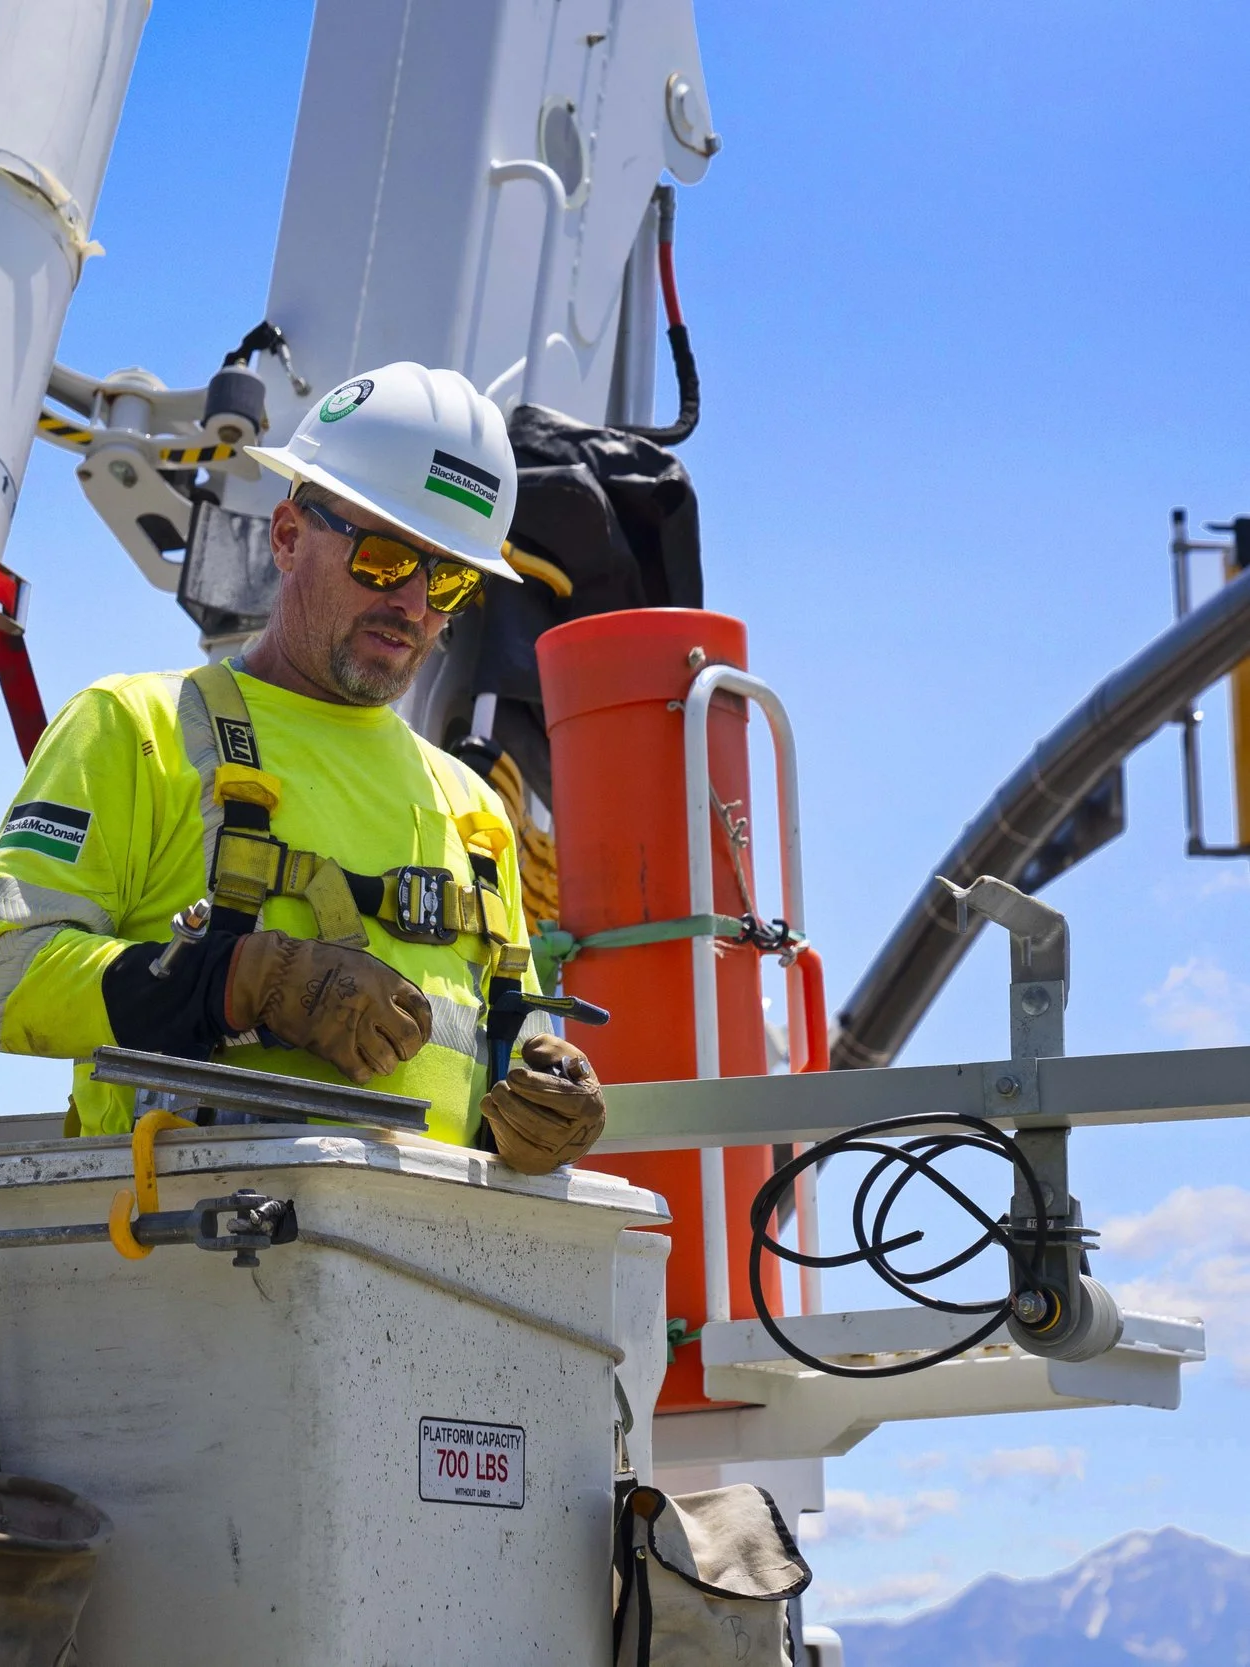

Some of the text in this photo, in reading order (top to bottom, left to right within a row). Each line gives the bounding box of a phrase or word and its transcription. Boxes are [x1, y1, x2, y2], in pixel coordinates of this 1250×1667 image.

[430, 464, 498, 503] Black&McDonald
[423, 1425, 522, 1450] PLATFORM CAPACITY
[436, 1448, 509, 1483] 700 LBS
[455, 1487, 491, 1498] WITHOUT LINER
